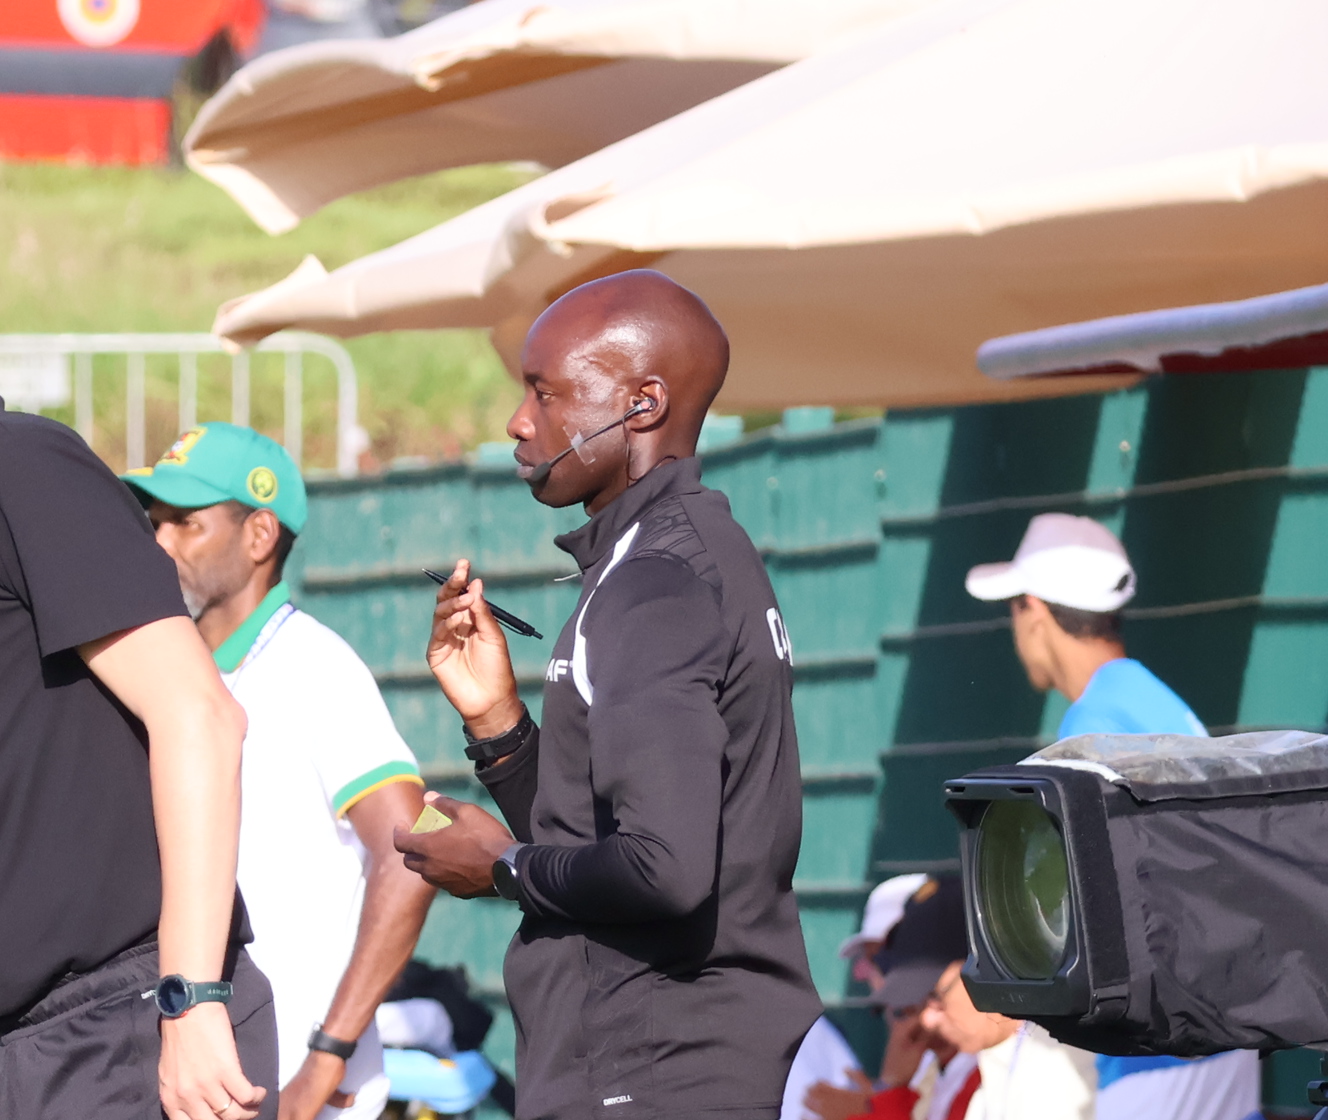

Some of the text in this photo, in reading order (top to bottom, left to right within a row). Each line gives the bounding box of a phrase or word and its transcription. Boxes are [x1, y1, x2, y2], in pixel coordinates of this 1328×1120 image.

[766, 607, 793, 667] CA
[545, 658, 569, 682] AF
[603, 1095, 633, 1106] DRYCELL
